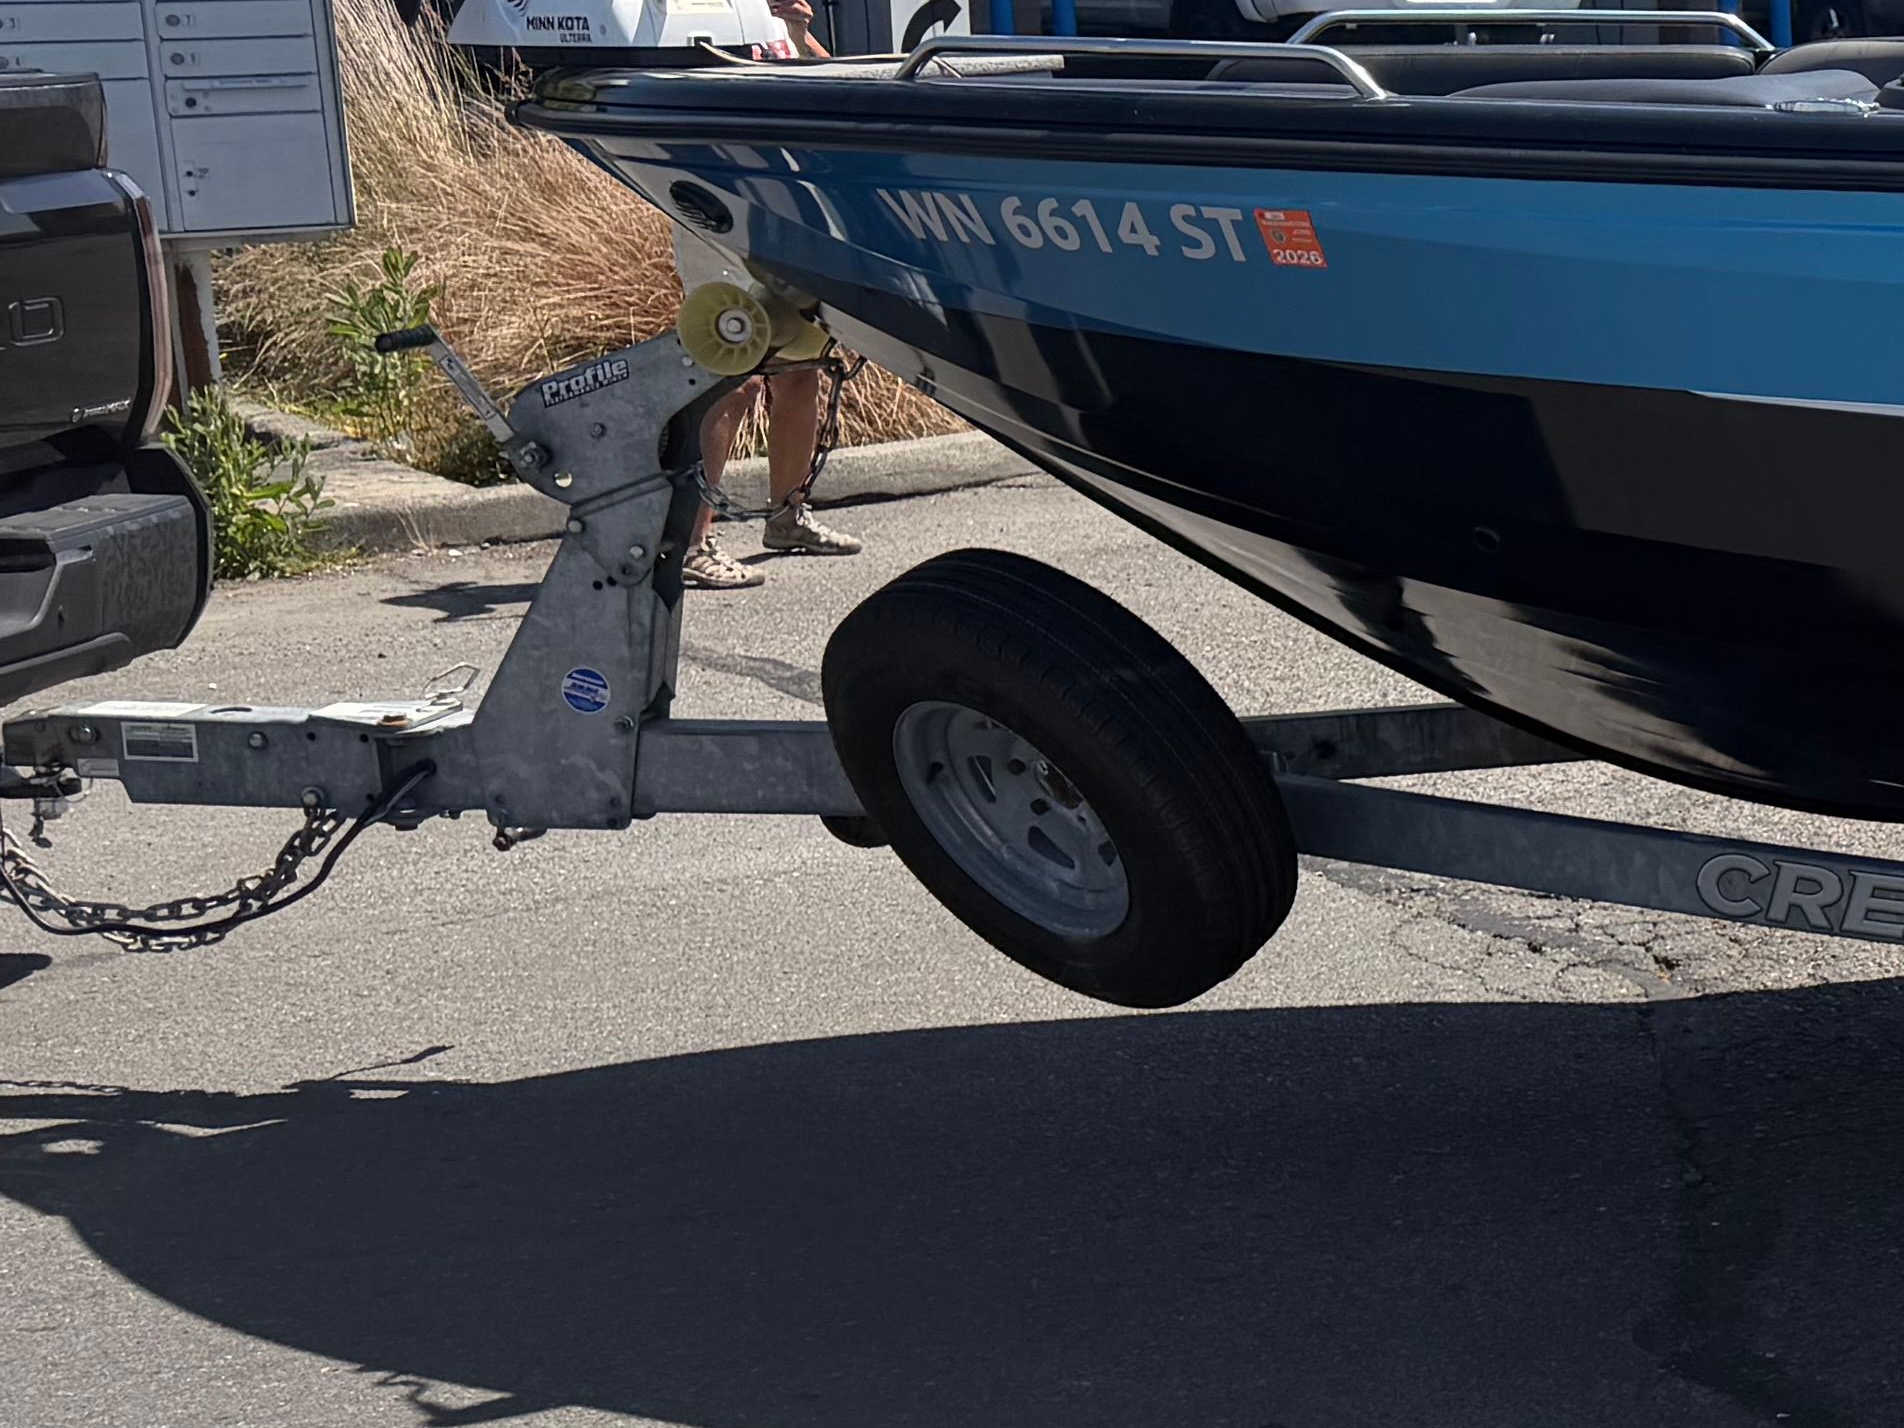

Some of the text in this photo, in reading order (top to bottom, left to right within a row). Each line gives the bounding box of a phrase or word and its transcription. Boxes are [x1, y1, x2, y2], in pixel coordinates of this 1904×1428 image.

[526, 15, 590, 32] MINN KOTA
[877, 188, 996, 246] WN
[1000, 195, 1162, 257] 6614
[1169, 203, 1247, 263] ST
[1272, 248, 1324, 265] 2026
[541, 359, 629, 401] Profile
